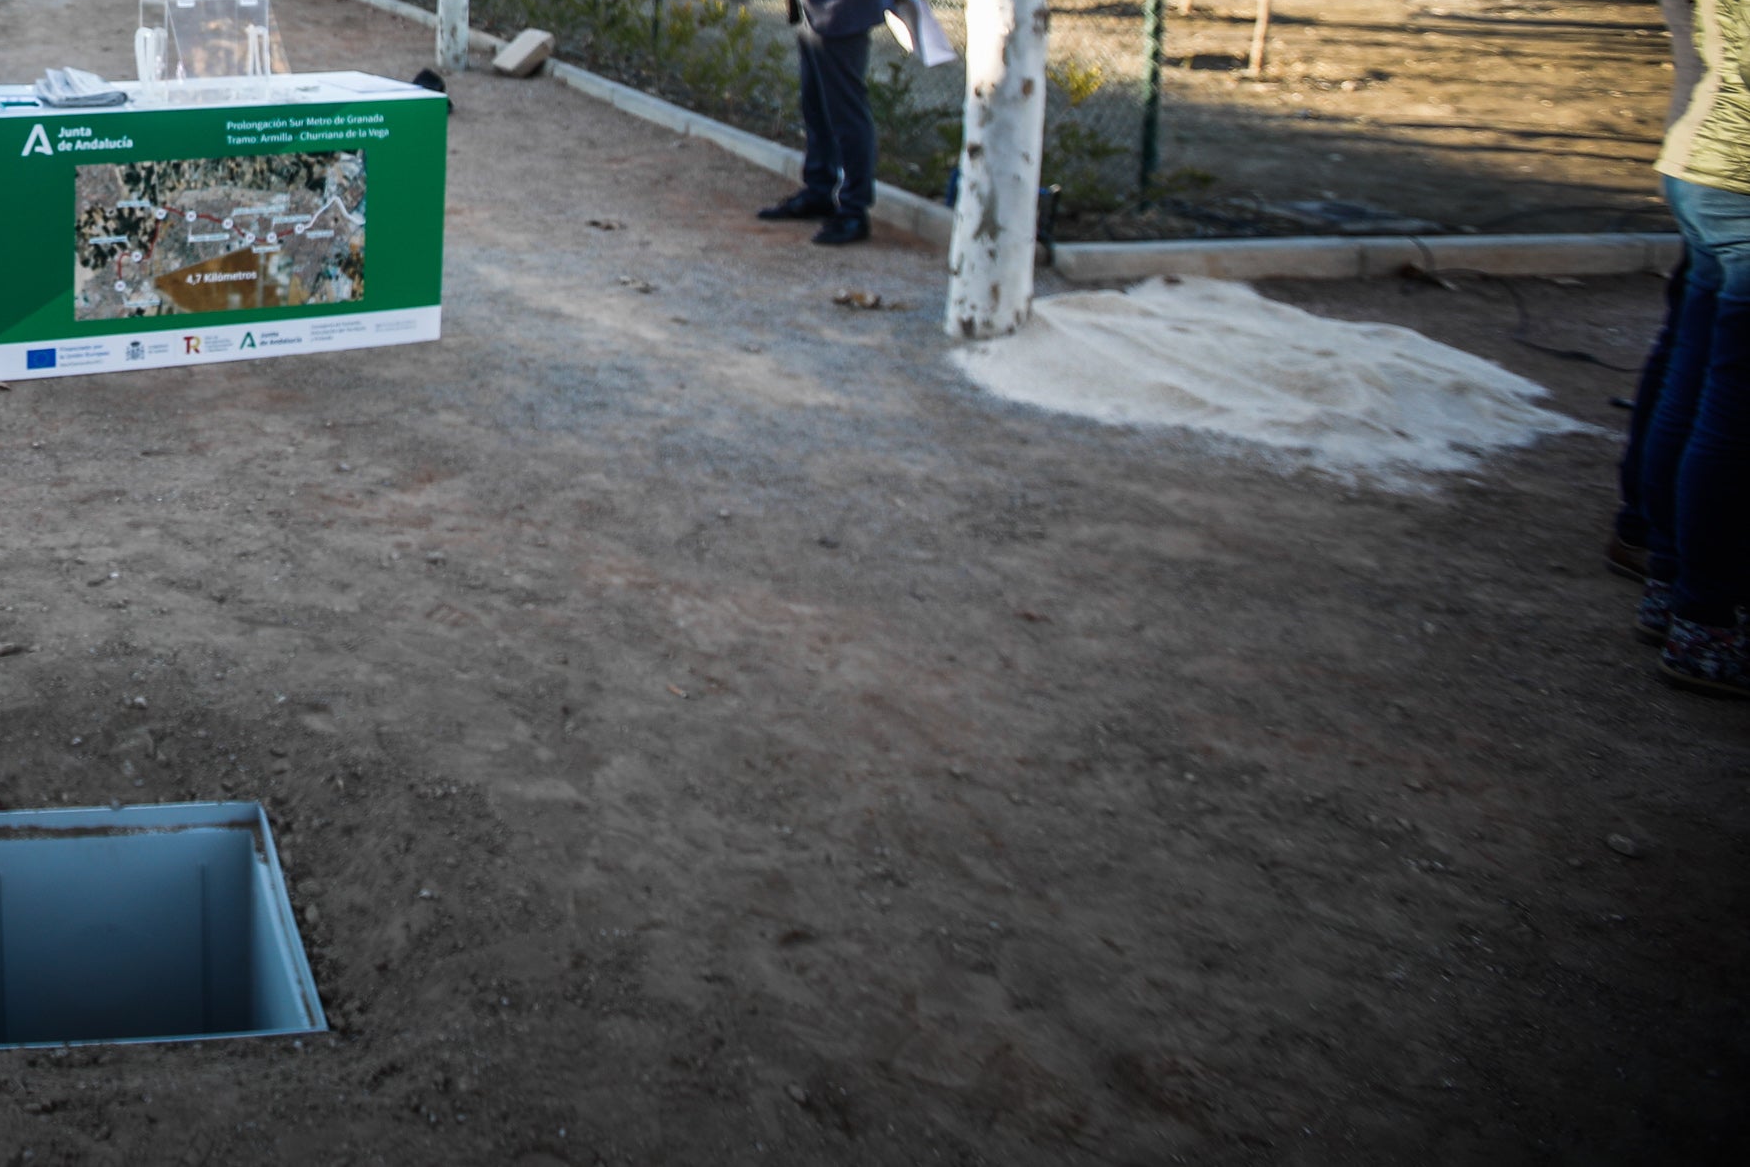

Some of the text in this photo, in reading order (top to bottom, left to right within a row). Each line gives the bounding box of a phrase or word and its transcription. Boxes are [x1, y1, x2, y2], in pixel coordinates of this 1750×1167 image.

[226, 113, 385, 132] Prolongación Sur Metro de Granada
[58, 126, 93, 138] Junta
[260, 132, 293, 143] Armilla
[345, 129, 357, 139] de
[358, 128, 367, 138] la
[368, 128, 390, 139] Vega
[57, 135, 134, 152] de Andalucía
[186, 271, 258, 286] 4,7 Kilómetros
